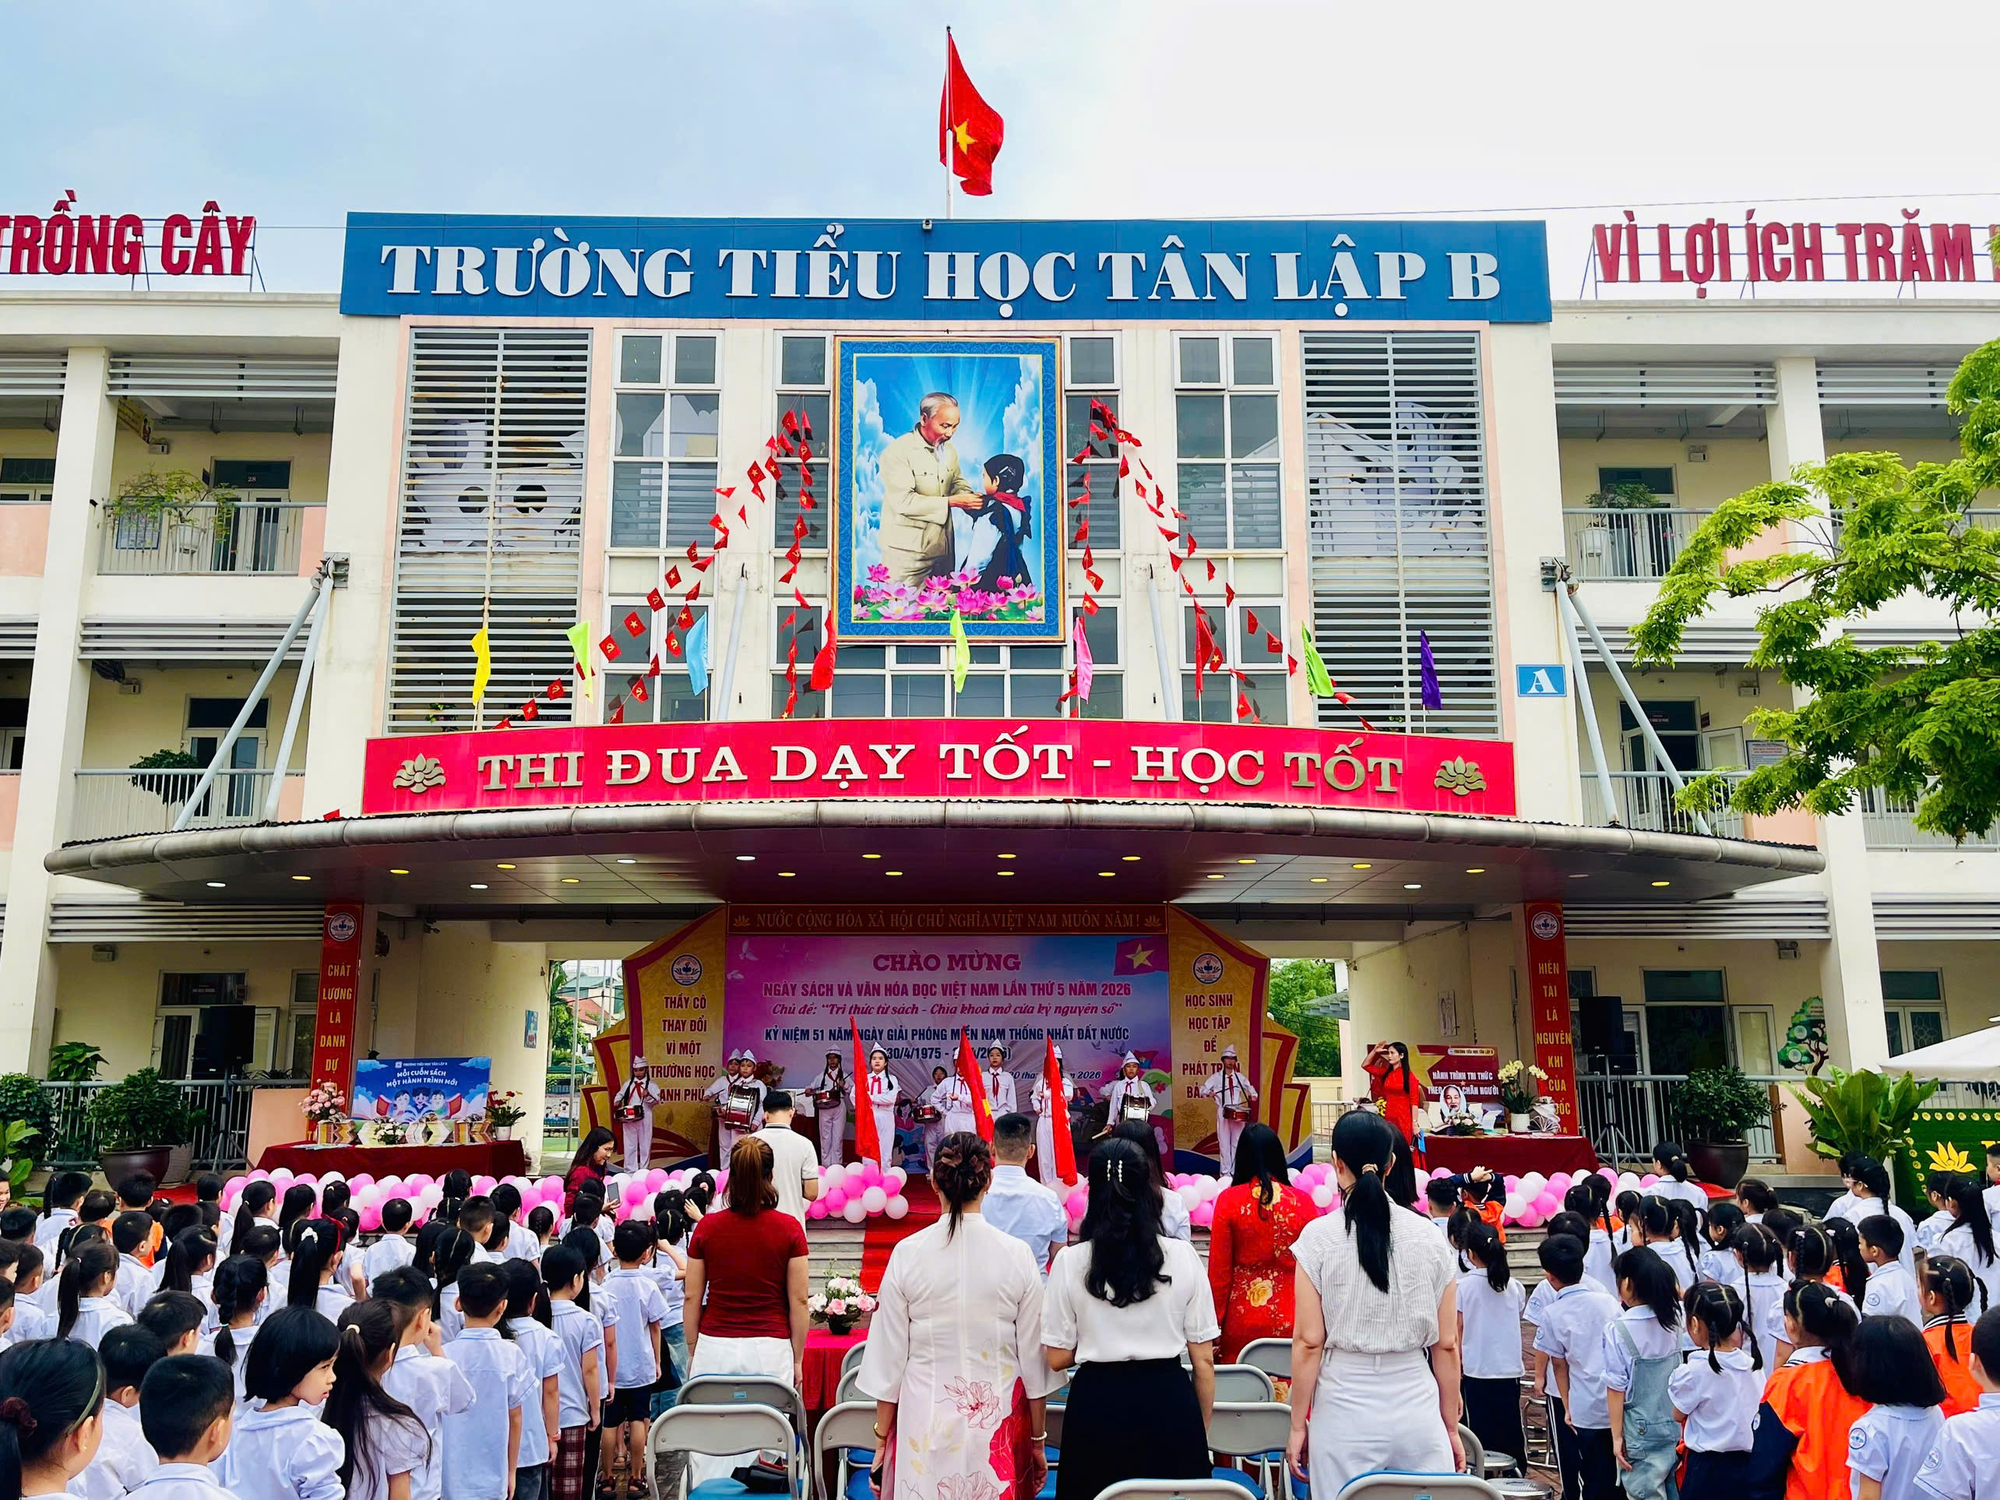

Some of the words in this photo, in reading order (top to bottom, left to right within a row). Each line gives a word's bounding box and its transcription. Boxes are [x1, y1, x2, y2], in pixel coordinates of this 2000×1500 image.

[161, 201, 256, 275] CÂY
[1595, 210, 1640, 283] VÌ
[1657, 218, 1731, 299] LỢI
[1746, 208, 1823, 282] ÍCH
[1836, 208, 1975, 282] TRĂM
[381, 227, 693, 298] TRƯỜNG
[719, 223, 900, 299] TIỂU
[923, 252, 1076, 318] HỌC
[1099, 235, 1250, 300] TÂN
[1273, 234, 1426, 316] LẬP
[1446, 252, 1500, 299] B
[1527, 668, 1558, 693] A
[477, 751, 584, 791] THI
[606, 746, 748, 786] ĐUA
[770, 744, 915, 789] DẠY
[939, 725, 1073, 780] TỐT
[1131, 746, 1264, 794] HỌC
[1284, 737, 1402, 792] TỐT
[756, 909, 793, 927] NƯỚC
[797, 910, 832, 931] CỘNG
[836, 910, 863, 927] HÒA
[890, 910, 913, 931] HỘI
[917, 908, 945, 927] CHỦ
[992, 910, 1023, 931] VIỆT
[1028, 914, 1057, 927] NAM
[1062, 910, 1100, 927] MUÔN
[873, 950, 941, 971] CHÀO
[947, 950, 1021, 971] MỪNG
[323, 987, 352, 1003] LƯỢNG
[763, 982, 797, 997] NGÀY
[801, 981, 833, 996] SÁCH
[837, 981, 852, 996] VÀ
[857, 981, 881, 996] VĂN
[884, 981, 908, 996] HÓA
[912, 983, 937, 999] ĐỌC
[941, 981, 966, 999] VIỆT
[971, 983, 999, 996] NAM
[1030, 981, 1055, 996] THỨ
[1058, 983, 1065, 996] 5
[1069, 981, 1097, 996] NĂM
[1101, 983, 1131, 996] 2026
[693, 994, 707, 1009] CÔ
[849, 1003, 874, 1015] thức
[876, 1002, 889, 1015] từ
[891, 1003, 919, 1015] sách
[992, 1003, 1012, 1015] mở
[1054, 1002, 1098, 1017] nguyên
[1185, 995, 1205, 1009] HỌC
[1209, 995, 1233, 1007] SINH
[662, 1020, 687, 1031] THAY
[690, 1015, 707, 1031] ĐỔI
[1189, 1018, 1208, 1032] HỌC
[1212, 1015, 1231, 1032] TẬP
[320, 1035, 346, 1048] DANH
[765, 1025, 780, 1040] KỶ
[782, 1026, 809, 1043] NIỆM
[813, 1029, 824, 1040] 51
[829, 1026, 852, 1040] NĂM
[857, 1026, 884, 1040] NGÀY
[887, 1025, 908, 1040] GIẢI
[911, 1025, 947, 1040] PHÓNG
[951, 1024, 978, 1040] MỀN
[981, 1029, 1006, 1040] NAM
[1009, 1024, 1043, 1040] THỐNG
[1047, 1024, 1074, 1040] NHẤT
[1077, 1024, 1097, 1040] ĐẤT
[1101, 1024, 1129, 1040] NƯỚC
[1536, 1029, 1572, 1045] NGUYÊN
[666, 1040, 676, 1055] VÌ
[679, 1041, 701, 1057] MỘT
[1204, 1035, 1217, 1052] ĐỂ
[325, 1057, 340, 1074] DỰ
[411, 1067, 429, 1076] CUỐN
[430, 1068, 446, 1076] SÁCH
[651, 1063, 691, 1078] TRƯỜNG
[695, 1066, 715, 1080] HỌC
[1182, 1060, 1209, 1075] PHÁT
[1211, 1063, 1240, 1075] TRN
[386, 1079, 401, 1088] MỘT
[402, 1076, 422, 1085] HÀNH
[423, 1076, 443, 1084] TRÌNH
[444, 1078, 458, 1086] MỚI
[1078, 1071, 1101, 1080] 2026
[1432, 1070, 1448, 1080] HÀNH
[660, 1089, 680, 1104] ẠNH
[684, 1086, 705, 1101] PHÚ
[1187, 1082, 1202, 1098] BẢ
